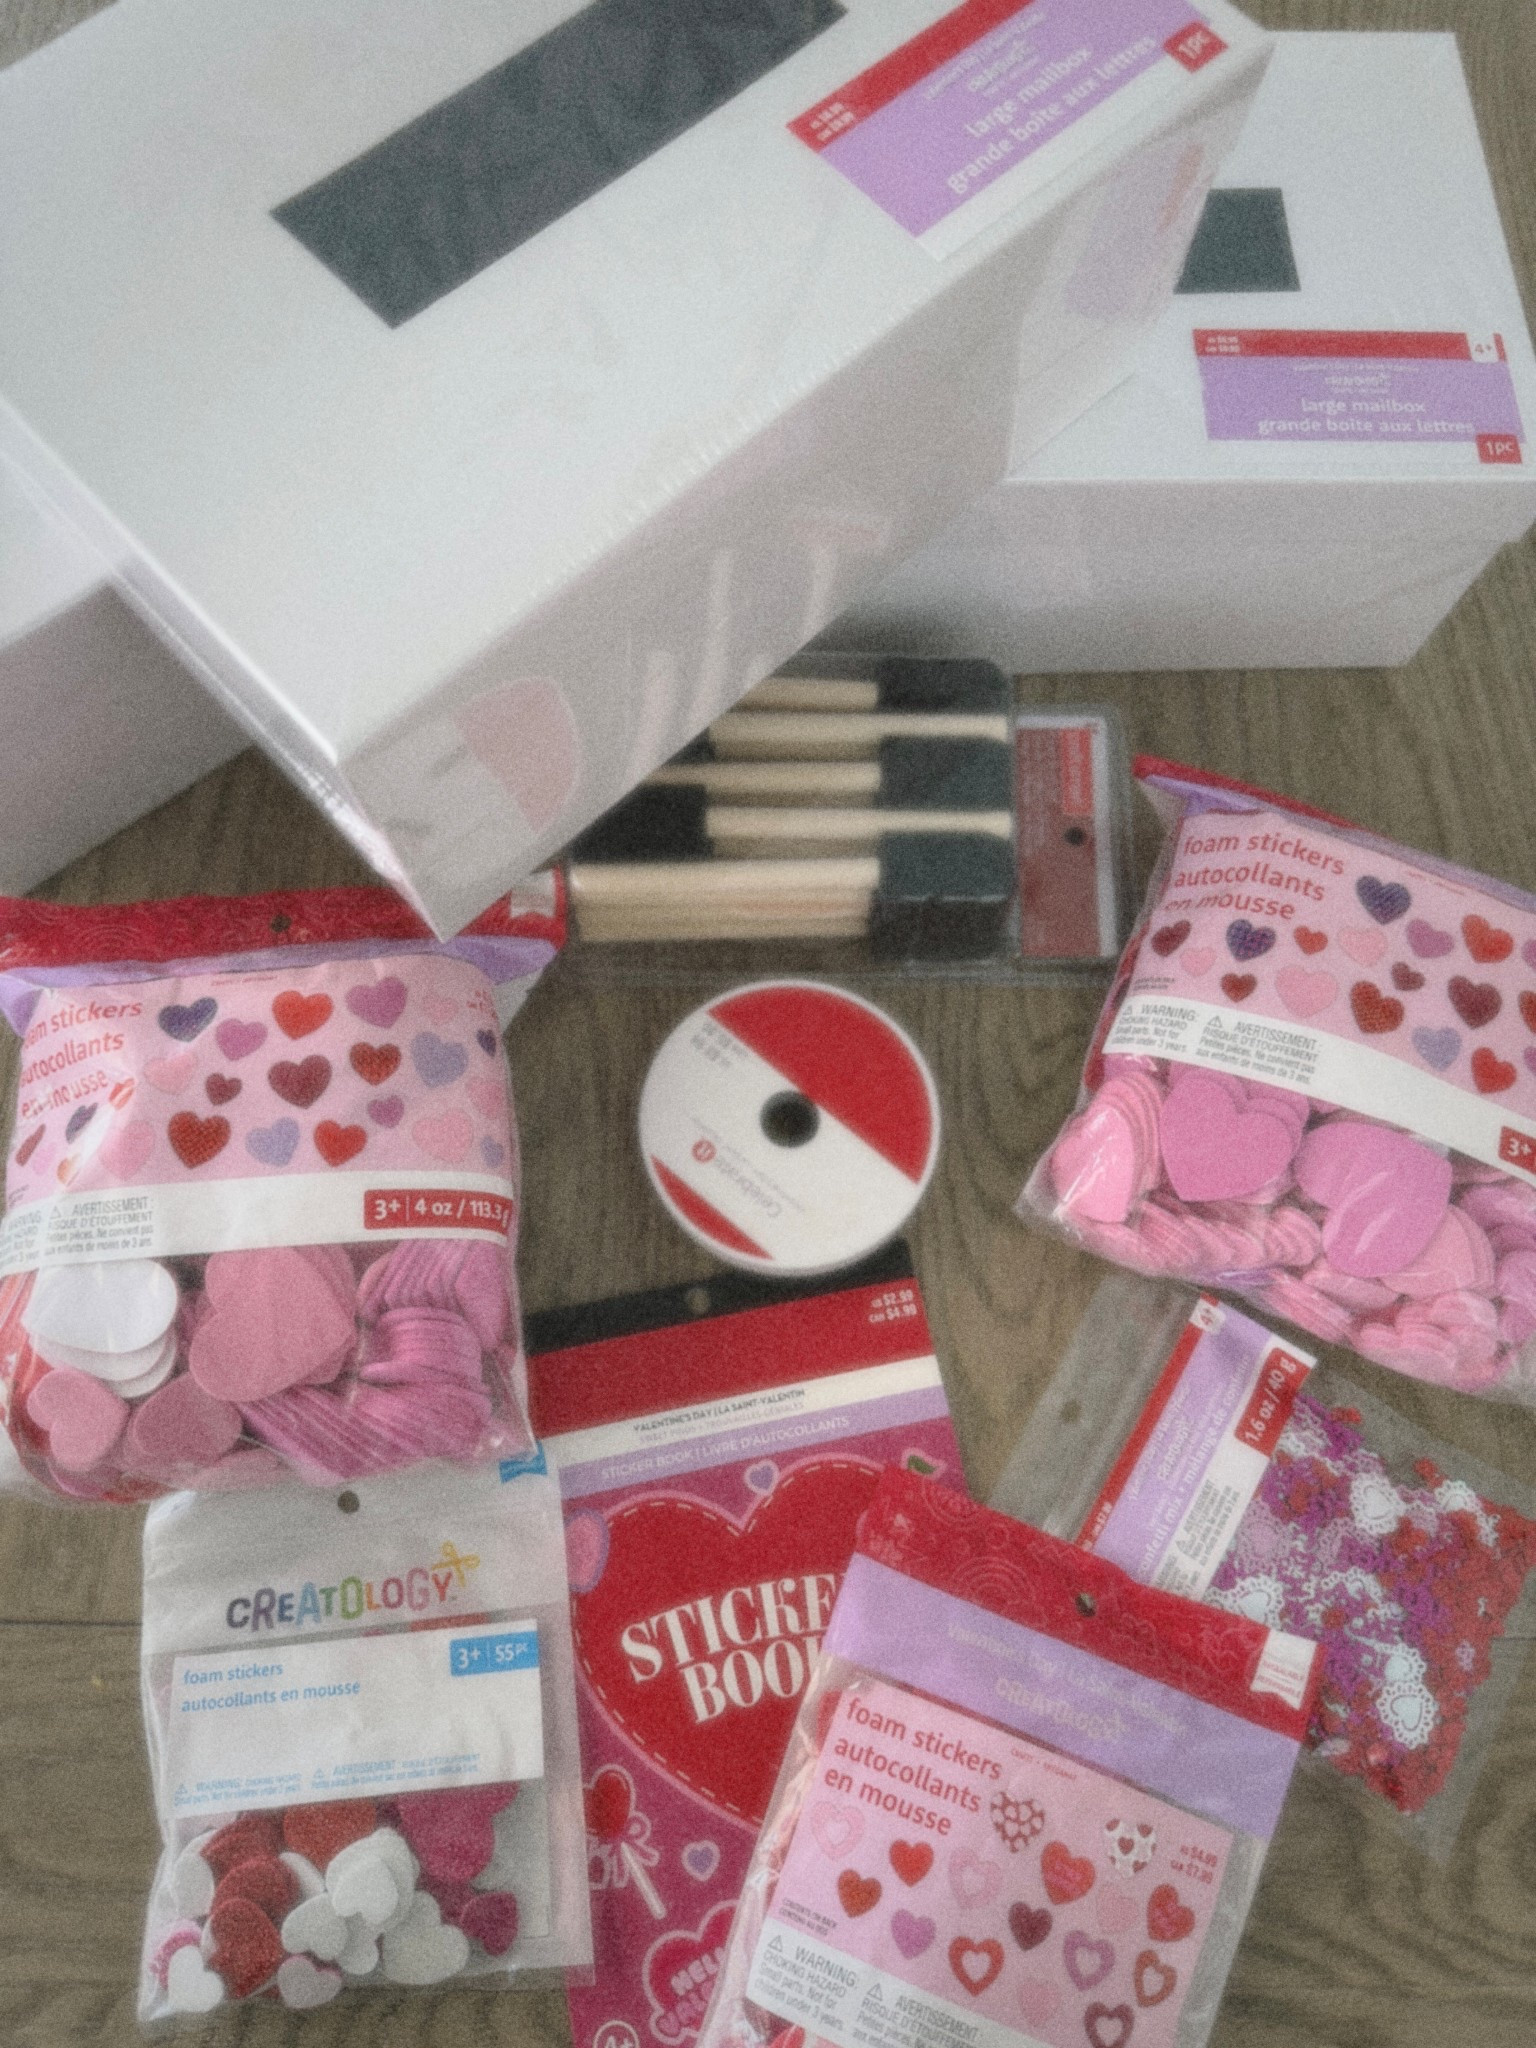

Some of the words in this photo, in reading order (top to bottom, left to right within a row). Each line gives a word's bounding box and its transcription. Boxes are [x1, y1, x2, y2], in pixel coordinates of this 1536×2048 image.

[965, 97, 1018, 139] large
[1017, 47, 1093, 107] mailbox
[948, 134, 1016, 195] grande
[1065, 78, 1097, 106] aux
[1093, 34, 1158, 80] lettres
[1301, 399, 1347, 416] large
[1353, 399, 1426, 414] mailbox
[1258, 418, 1321, 435] grande
[1380, 421, 1412, 432] aux
[1416, 419, 1475, 434] lettres
[1484, 440, 1514, 457] 1pc
[1183, 835, 1239, 856] foam
[1246, 832, 1345, 875] stickers
[1174, 861, 1326, 901] autocollants
[1165, 898, 1191, 912] en
[1196, 892, 1296, 920] mousse
[51, 1001, 143, 1034] stickers
[374, 1199, 400, 1221] 3+
[414, 1197, 427, 1216] 4
[431, 1202, 453, 1216] oz
[1244, 1418, 1267, 1443] 1.6
[1257, 1398, 1277, 1420] oz
[1267, 1368, 1287, 1392] 40
[1279, 1356, 1298, 1374] g
[1205, 1405, 1228, 1433] de
[601, 1460, 656, 1480] STICKER
[656, 1450, 692, 1468] BOOK
[702, 1439, 739, 1459] LIVRE
[1160, 1493, 1184, 1524] mix
[226, 1566, 453, 1633] CREATOLOGY
[621, 1572, 846, 1684] STICKE
[184, 1667, 224, 1686] foam
[227, 1662, 284, 1681] stickers
[458, 1646, 481, 1670] 3+
[181, 1690, 277, 1713] autocollants
[280, 1688, 299, 1702] en
[303, 1680, 361, 1699] mousse
[846, 1696, 907, 1741] foam
[912, 1729, 1003, 1781] stickers
[833, 1737, 982, 1814] autocollants
[824, 1767, 854, 1794] en
[858, 1781, 952, 1836] mousse
[763, 1950, 805, 1979] CHOKING
[806, 1972, 848, 1999] HAZARD
[794, 1944, 859, 1991] WARNING:
[861, 1997, 901, 2025] RISQUE
[895, 1996, 979, 2042] AVERTISSEMENT
